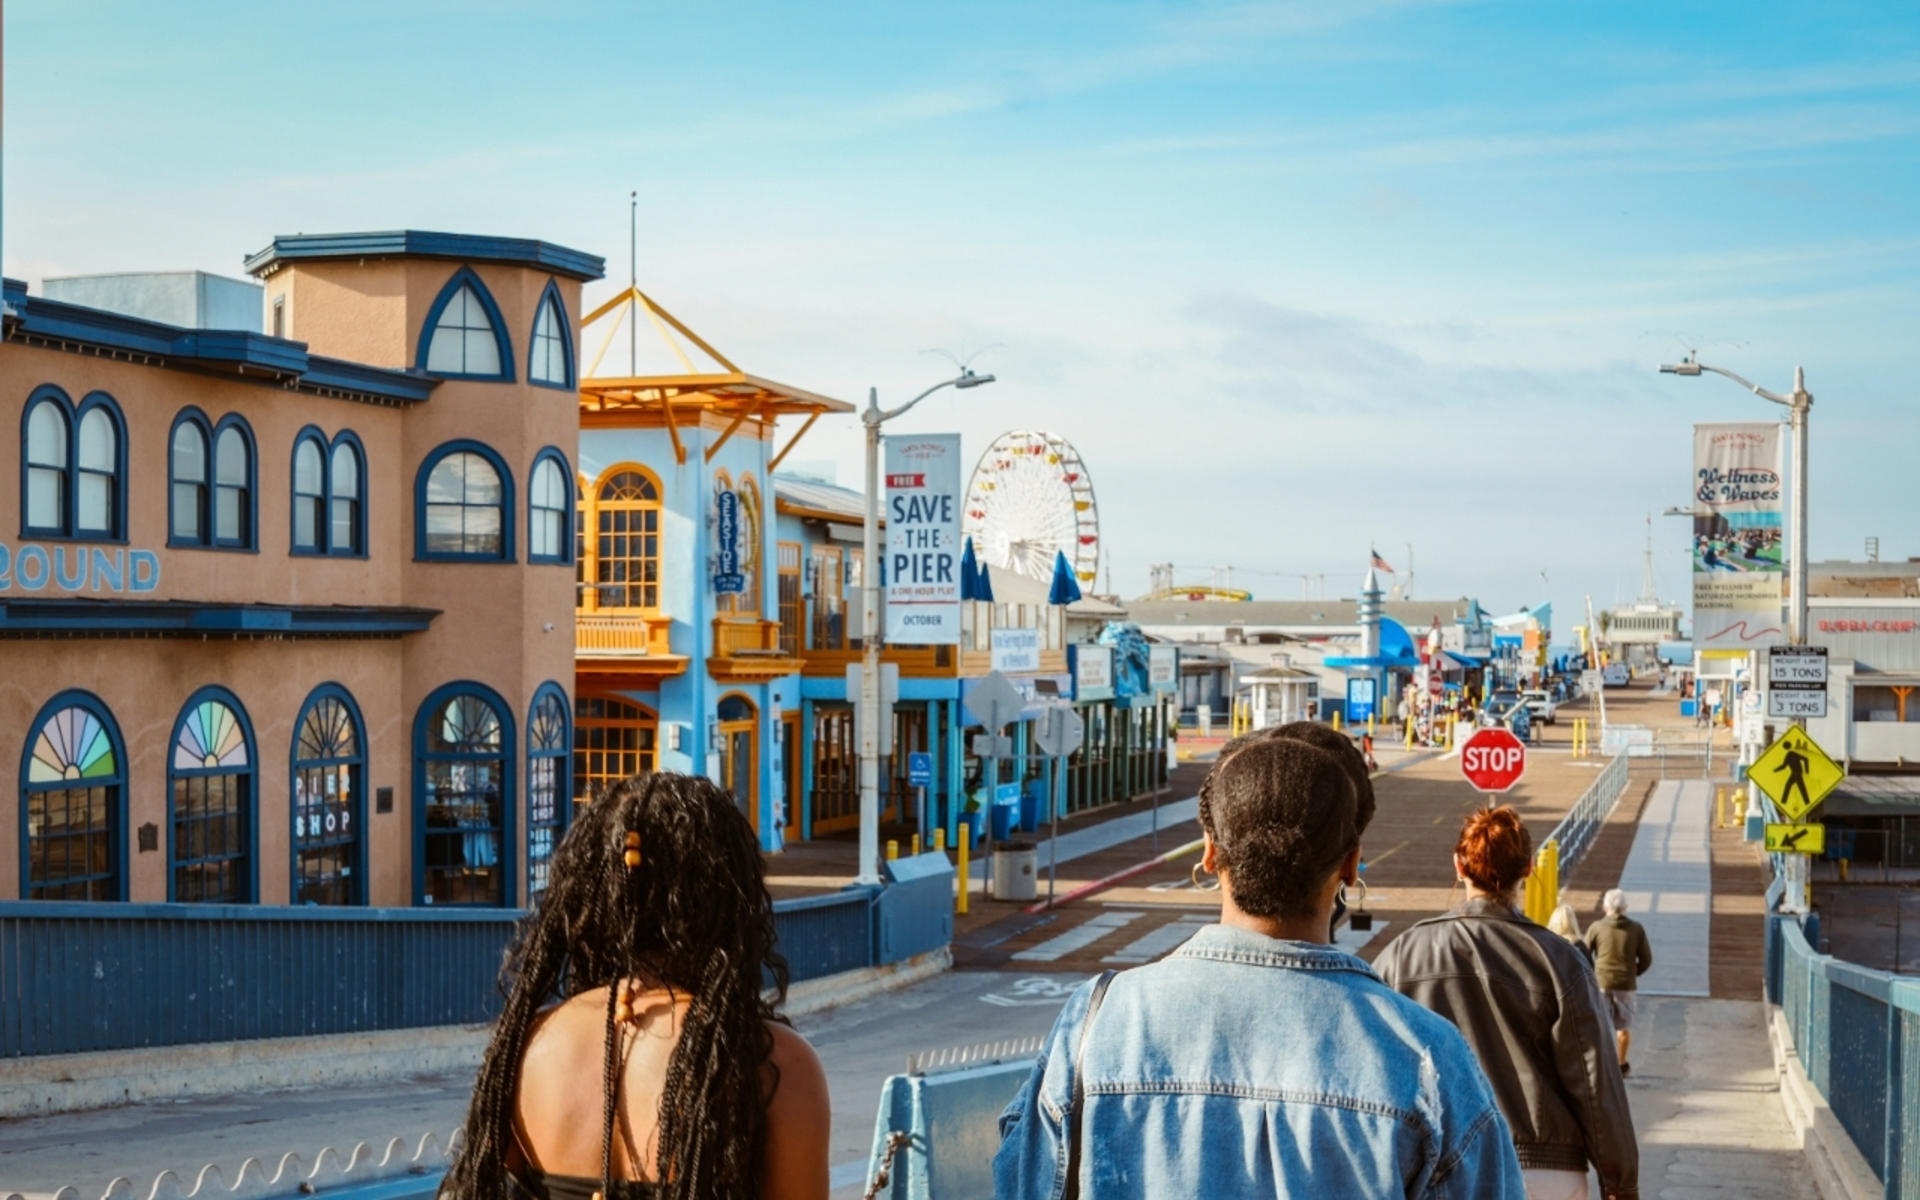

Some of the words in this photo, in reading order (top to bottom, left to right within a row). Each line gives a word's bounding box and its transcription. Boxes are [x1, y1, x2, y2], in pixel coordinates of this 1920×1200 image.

[893, 475, 915, 487] FREE
[1698, 467, 1778, 485] Wellness
[1697, 484, 1716, 502] &
[1720, 483, 1780, 502] Waves
[892, 494, 953, 524] SAVE
[722, 493, 733, 575] SEASIDE
[905, 528, 941, 549] THE
[893, 552, 954, 583] PIER
[902, 615, 943, 626] OCTOBER
[1775, 667, 1787, 678] 15
[1792, 667, 1822, 678] TONS
[1776, 702, 1785, 712] 3
[1789, 702, 1820, 713] TONS
[1464, 746, 1522, 772] STOP
[295, 773, 351, 796] PIER
[295, 810, 350, 838] SHOP
